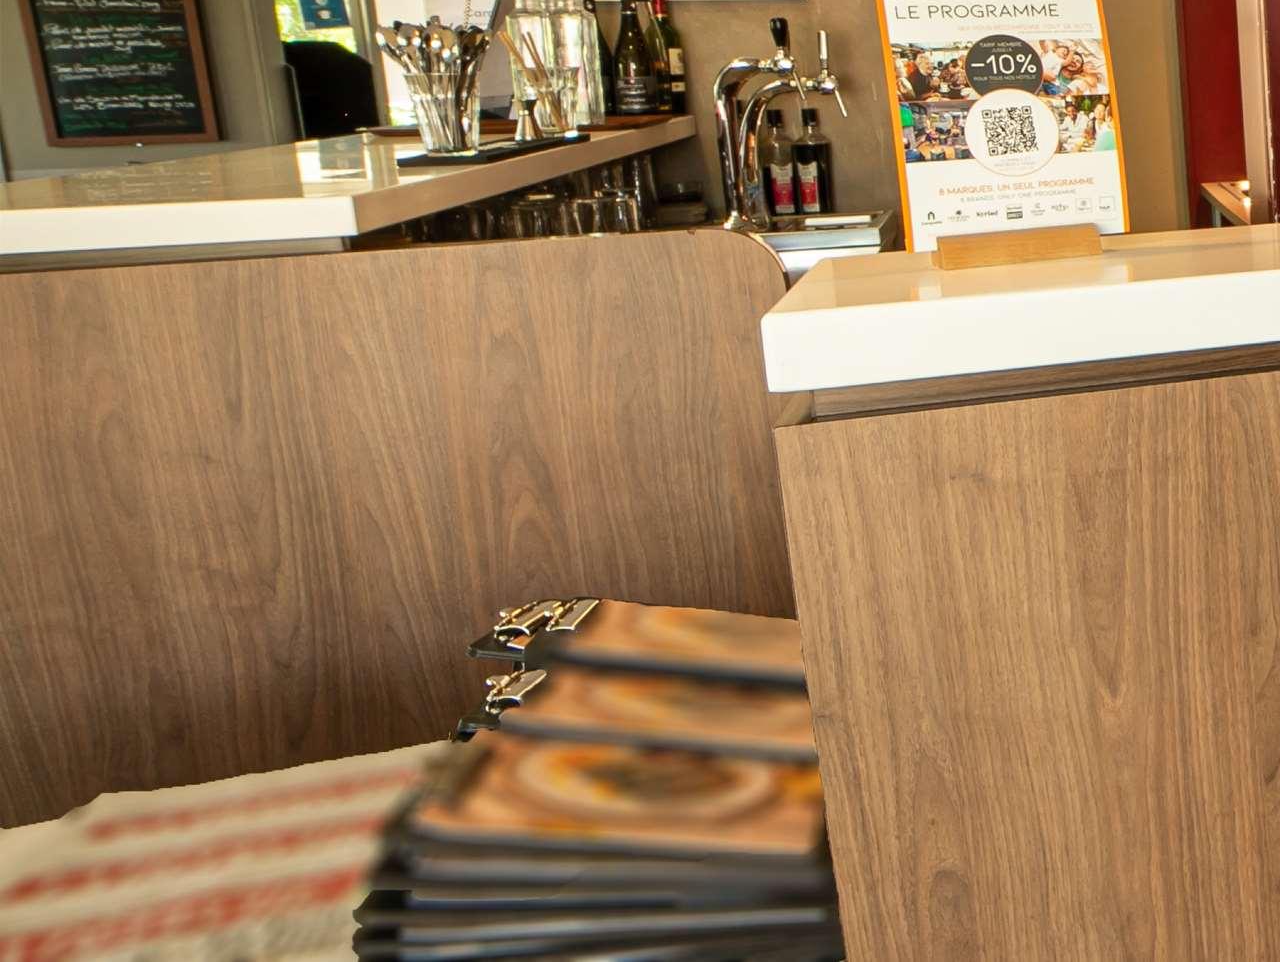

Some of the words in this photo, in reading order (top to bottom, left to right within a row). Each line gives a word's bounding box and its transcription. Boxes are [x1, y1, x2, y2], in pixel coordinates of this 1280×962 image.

[894, 5, 921, 20] LE
[927, 3, 1060, 19] PROGRAMME
[970, 53, 1037, 75] -10%
[997, 183, 1011, 192] UN
[1012, 180, 1035, 191] SEUL
[1038, 176, 1095, 189] PROGRAMME
